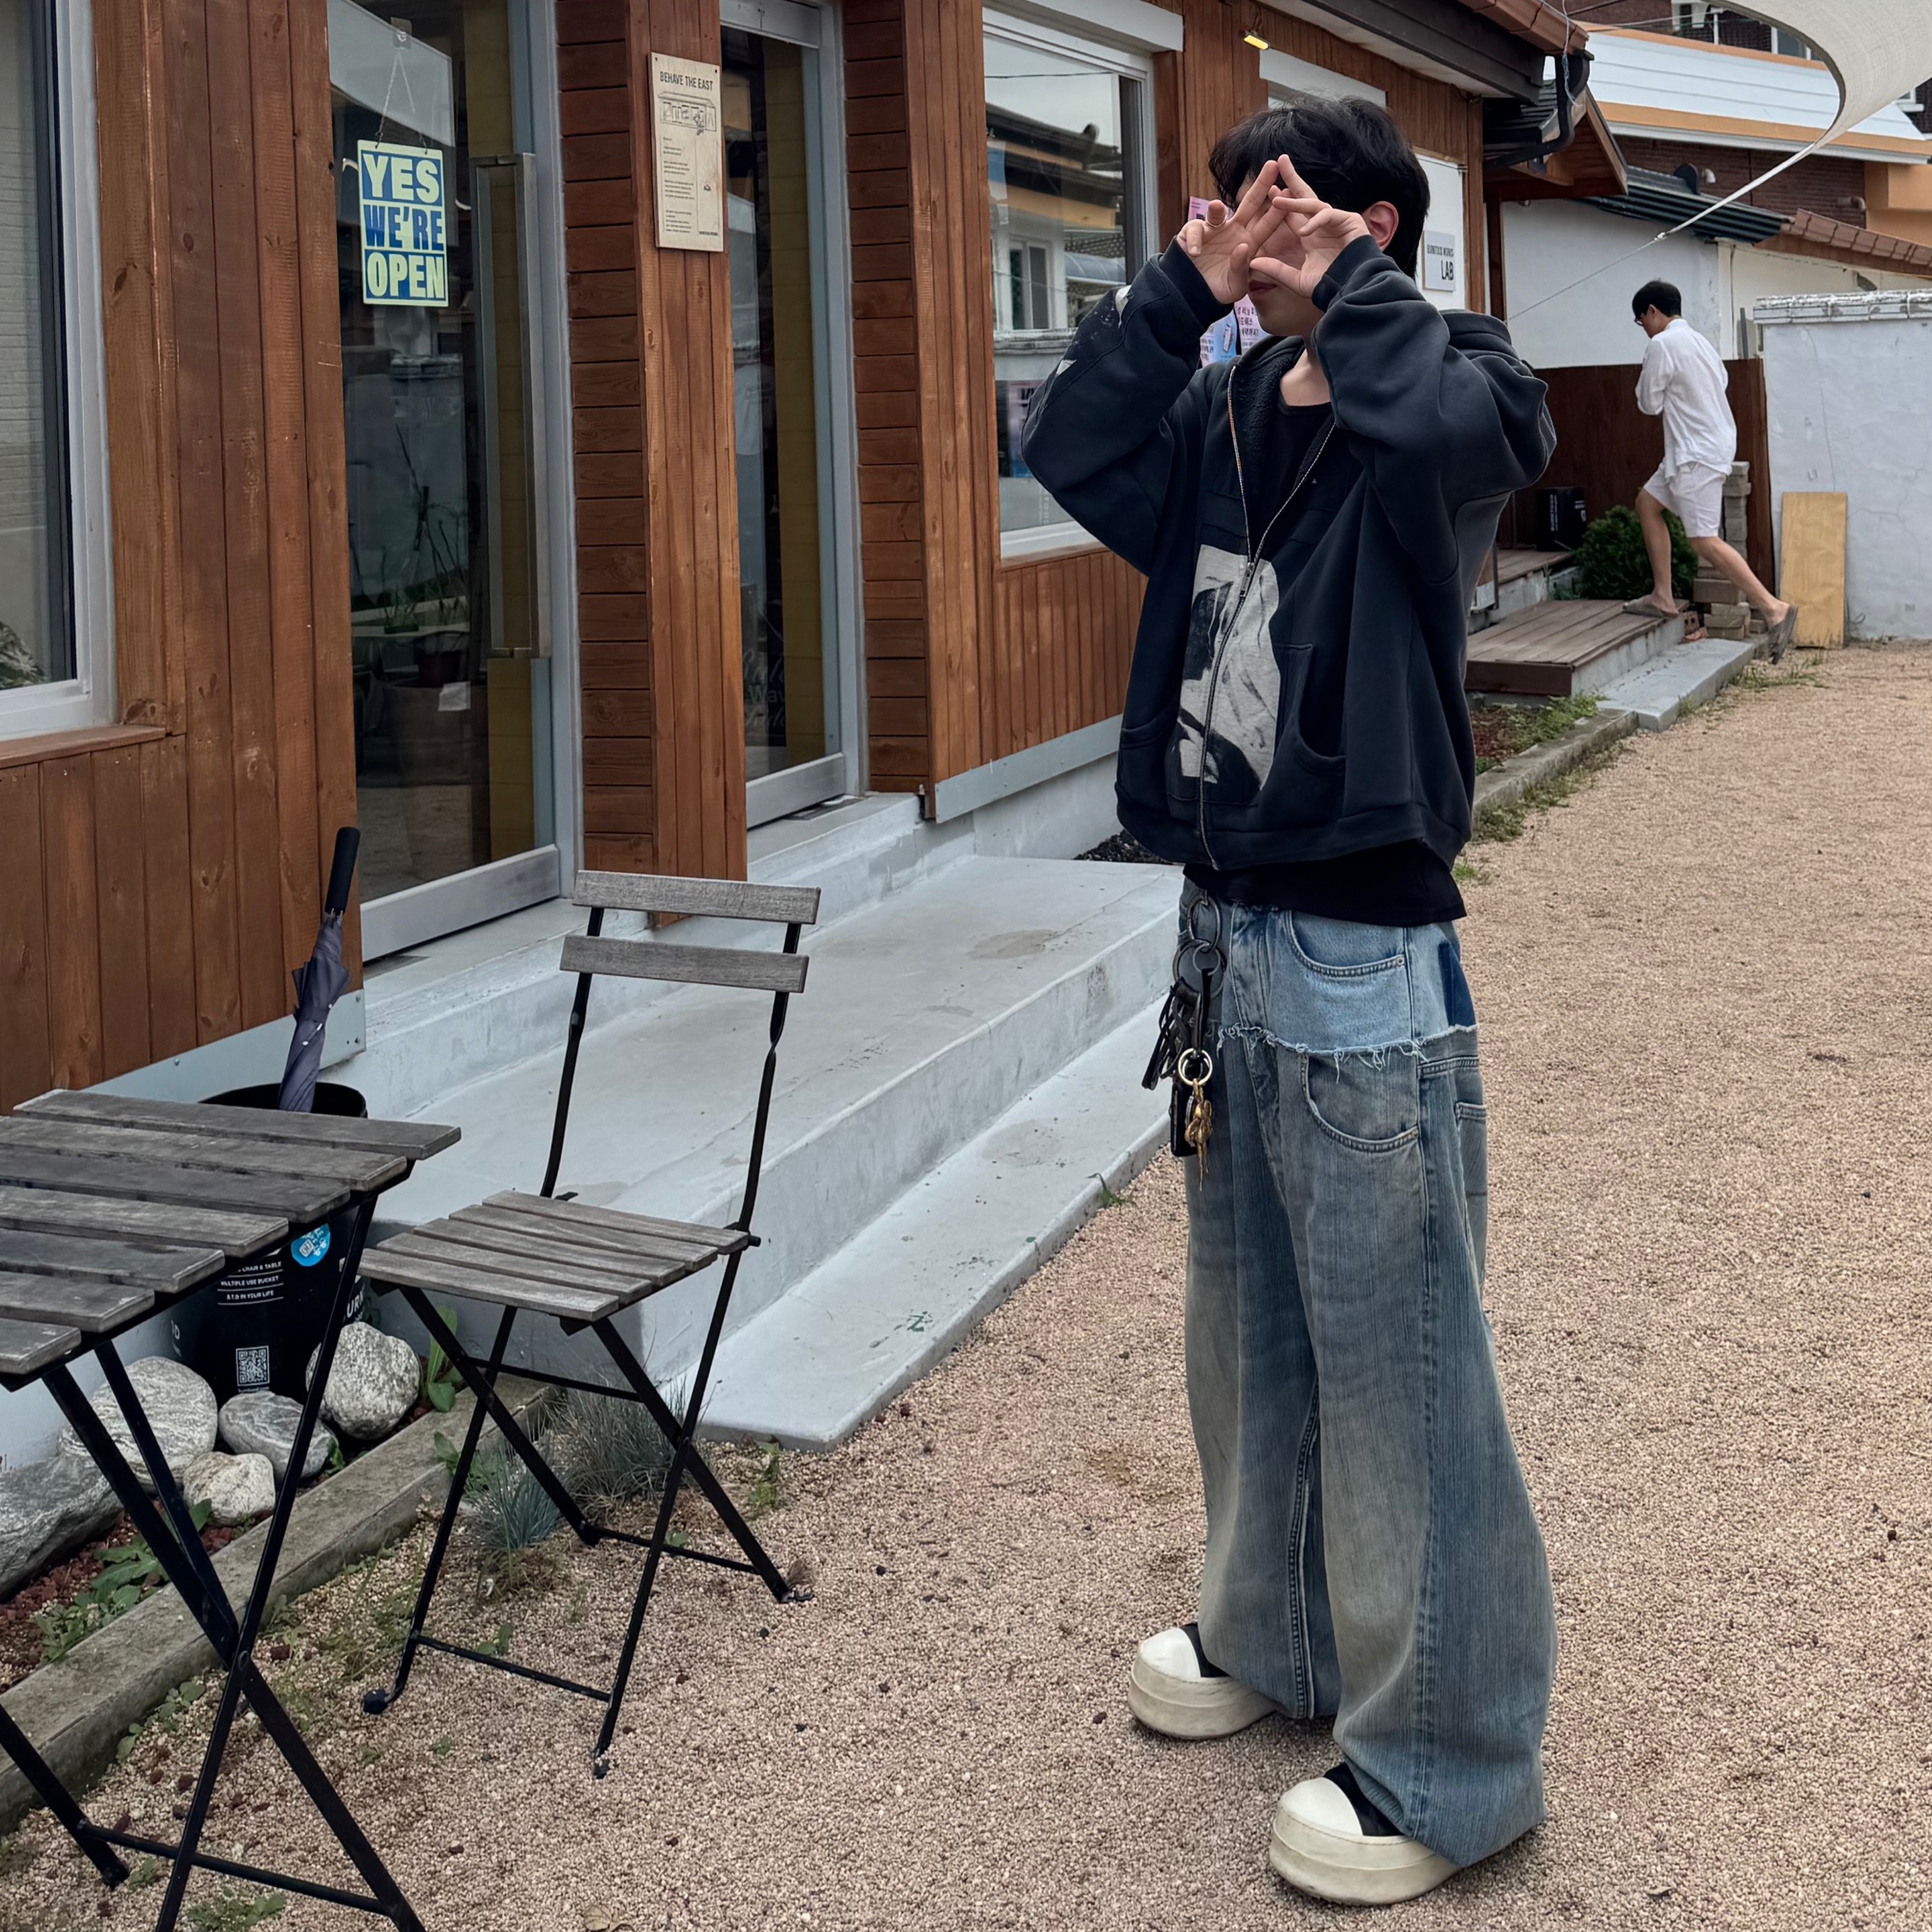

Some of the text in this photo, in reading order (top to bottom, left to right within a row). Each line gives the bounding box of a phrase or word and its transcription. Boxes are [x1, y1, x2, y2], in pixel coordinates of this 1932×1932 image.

[660, 71, 713, 91] BEHAVE THE EAST
[362, 153, 440, 204] YES
[363, 205, 444, 251] WE'RE
[367, 252, 444, 299] OPEN
[1441, 259, 1454, 280] LAB
